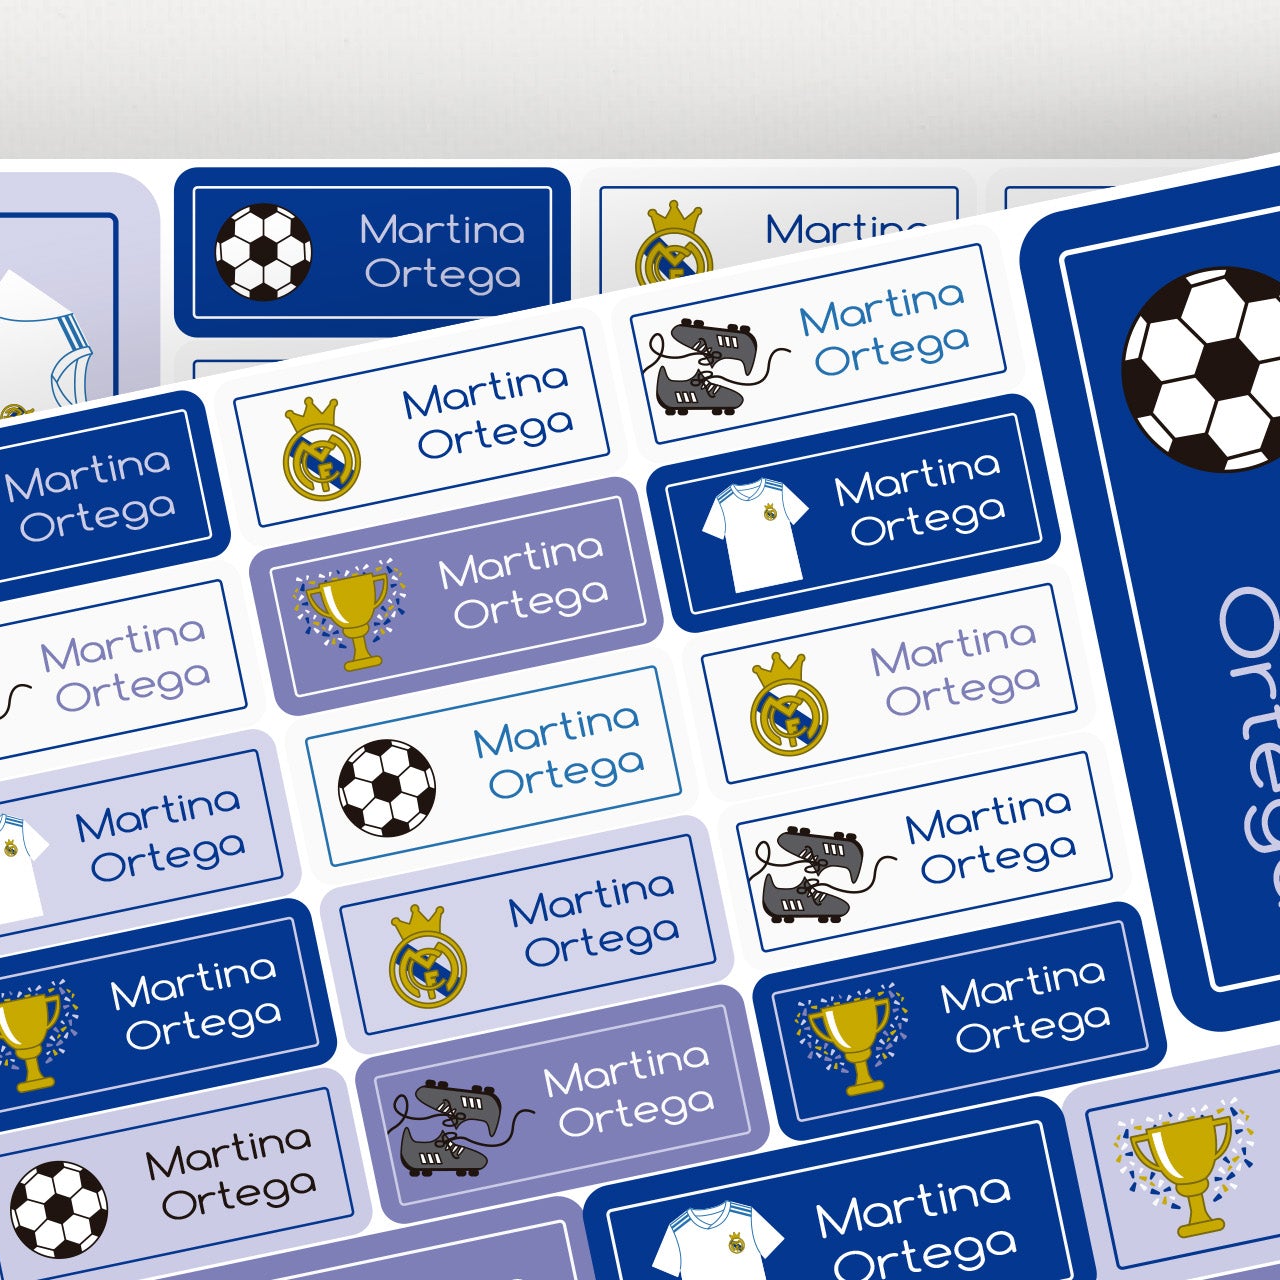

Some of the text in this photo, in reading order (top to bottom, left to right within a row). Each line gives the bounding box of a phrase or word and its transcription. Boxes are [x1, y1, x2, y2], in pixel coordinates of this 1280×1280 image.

[361, 214, 524, 243] Martina
[767, 214, 928, 243] Martin
[365, 258, 520, 296] Ortega
[800, 285, 964, 337] Martina
[815, 329, 969, 376] Ortega
[403, 368, 568, 420] Martina
[418, 412, 573, 459] Ortega
[5, 452, 170, 503] Martina
[835, 455, 1000, 507] Martina
[20, 496, 175, 542] Ortega
[851, 499, 1005, 546] Ortega
[439, 538, 603, 589] Martina
[454, 582, 608, 629] Ortega
[41, 621, 205, 672] Martina
[871, 625, 1036, 676] Martina
[56, 665, 210, 712] Ortega
[886, 669, 1040, 716] Ortega
[474, 708, 639, 759] Martina
[489, 752, 644, 799] Ortega
[76, 791, 240, 843] Martina
[906, 793, 1071, 845] Martina
[91, 835, 245, 882] Ortega
[921, 837, 1076, 884] Ortega
[509, 876, 674, 928] Martina
[525, 920, 679, 967] Ortega
[111, 959, 276, 1011] Martina
[941, 963, 1105, 1014] Martina
[126, 1003, 281, 1050] Ortega
[956, 1007, 1110, 1053] Ortega
[544, 1047, 709, 1097] Martina
[559, 1091, 714, 1137] Ortega
[146, 1129, 311, 1181] Martina
[162, 1173, 316, 1220] Ortega
[816, 1179, 1011, 1239] Martina
[834, 1231, 1017, 1280] Ortega
